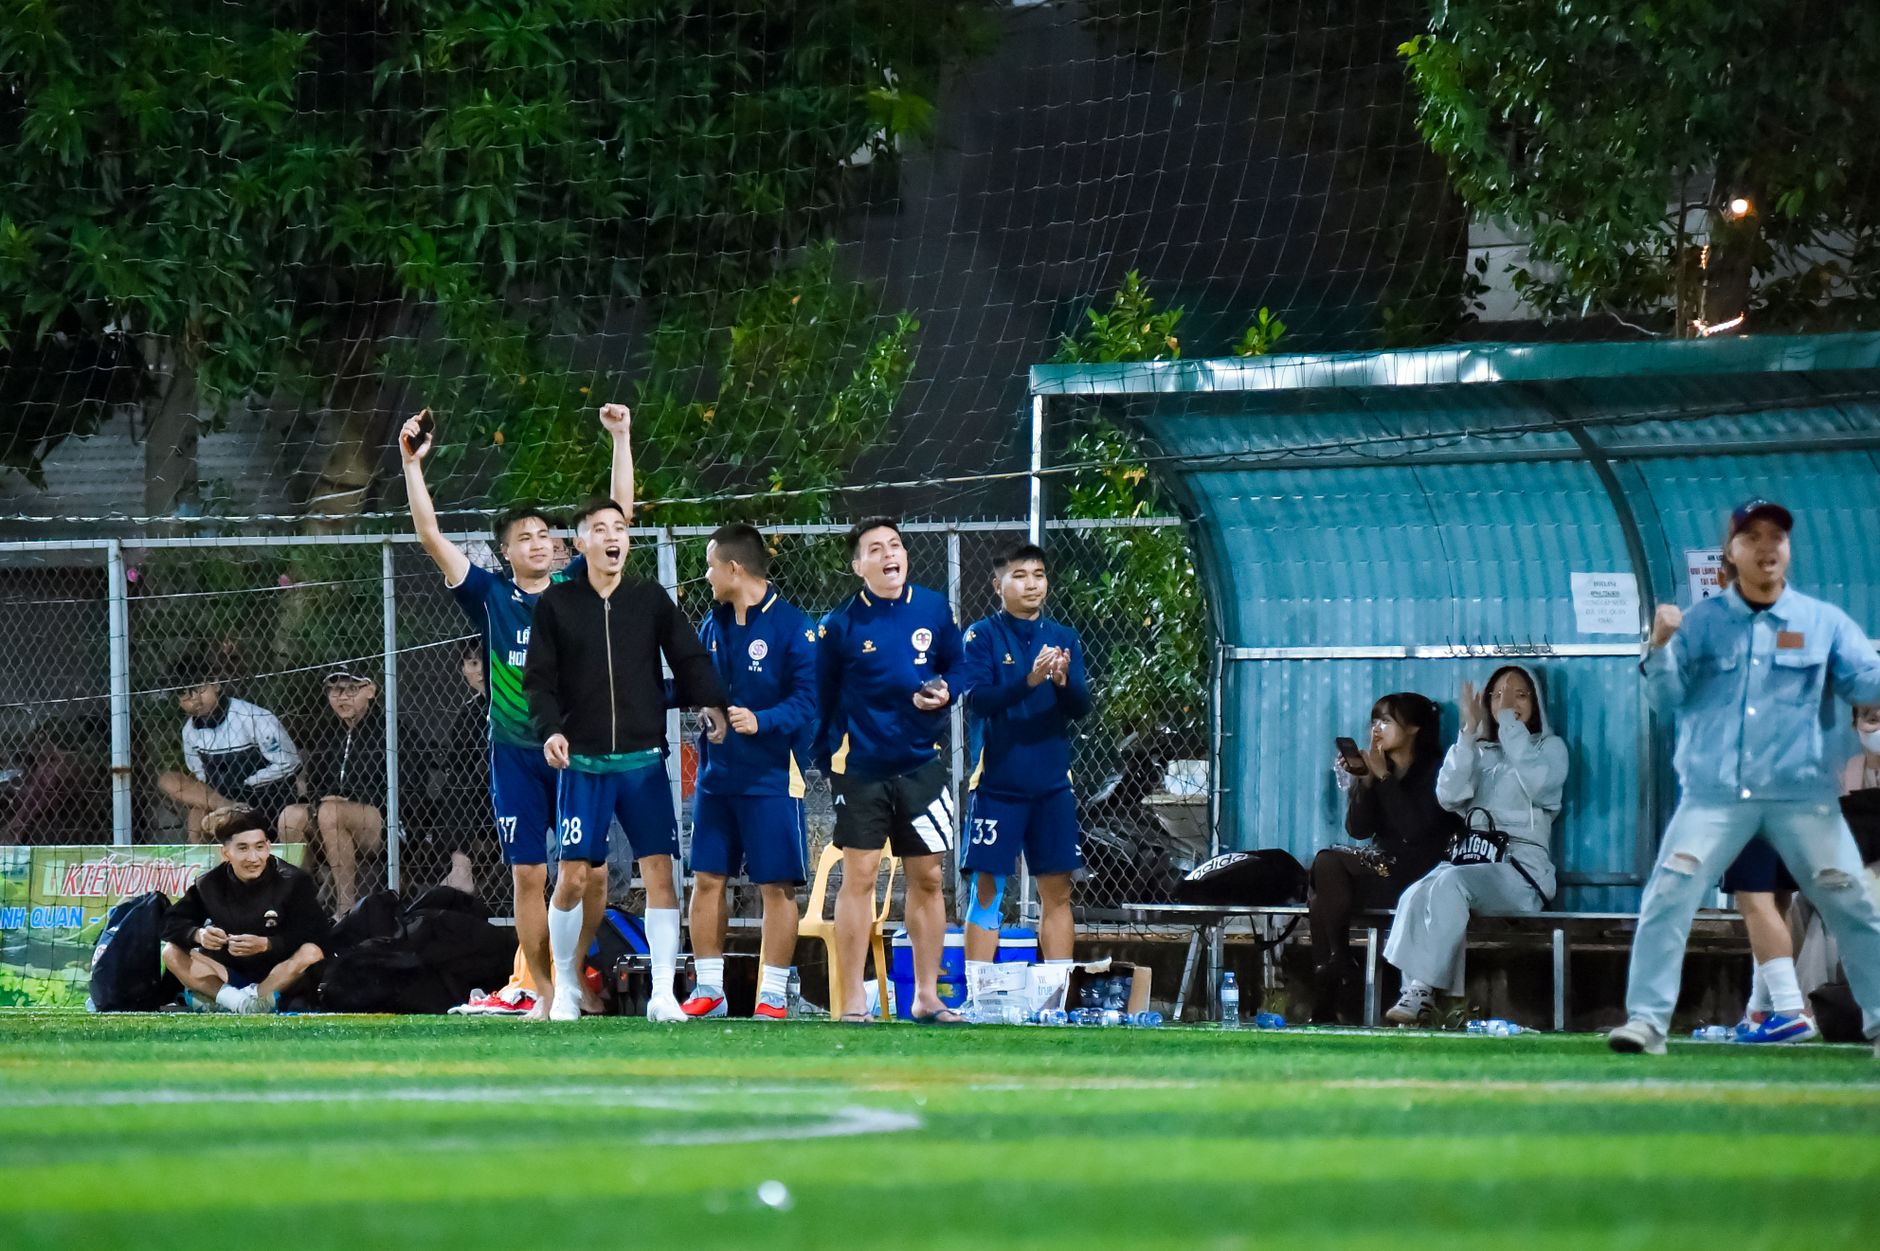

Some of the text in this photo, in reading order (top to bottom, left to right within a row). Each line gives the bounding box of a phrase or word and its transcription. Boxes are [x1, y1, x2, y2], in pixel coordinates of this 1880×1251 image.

[561, 816, 582, 846] 28
[972, 818, 998, 845] 33
[31, 906, 83, 929] QUAN
